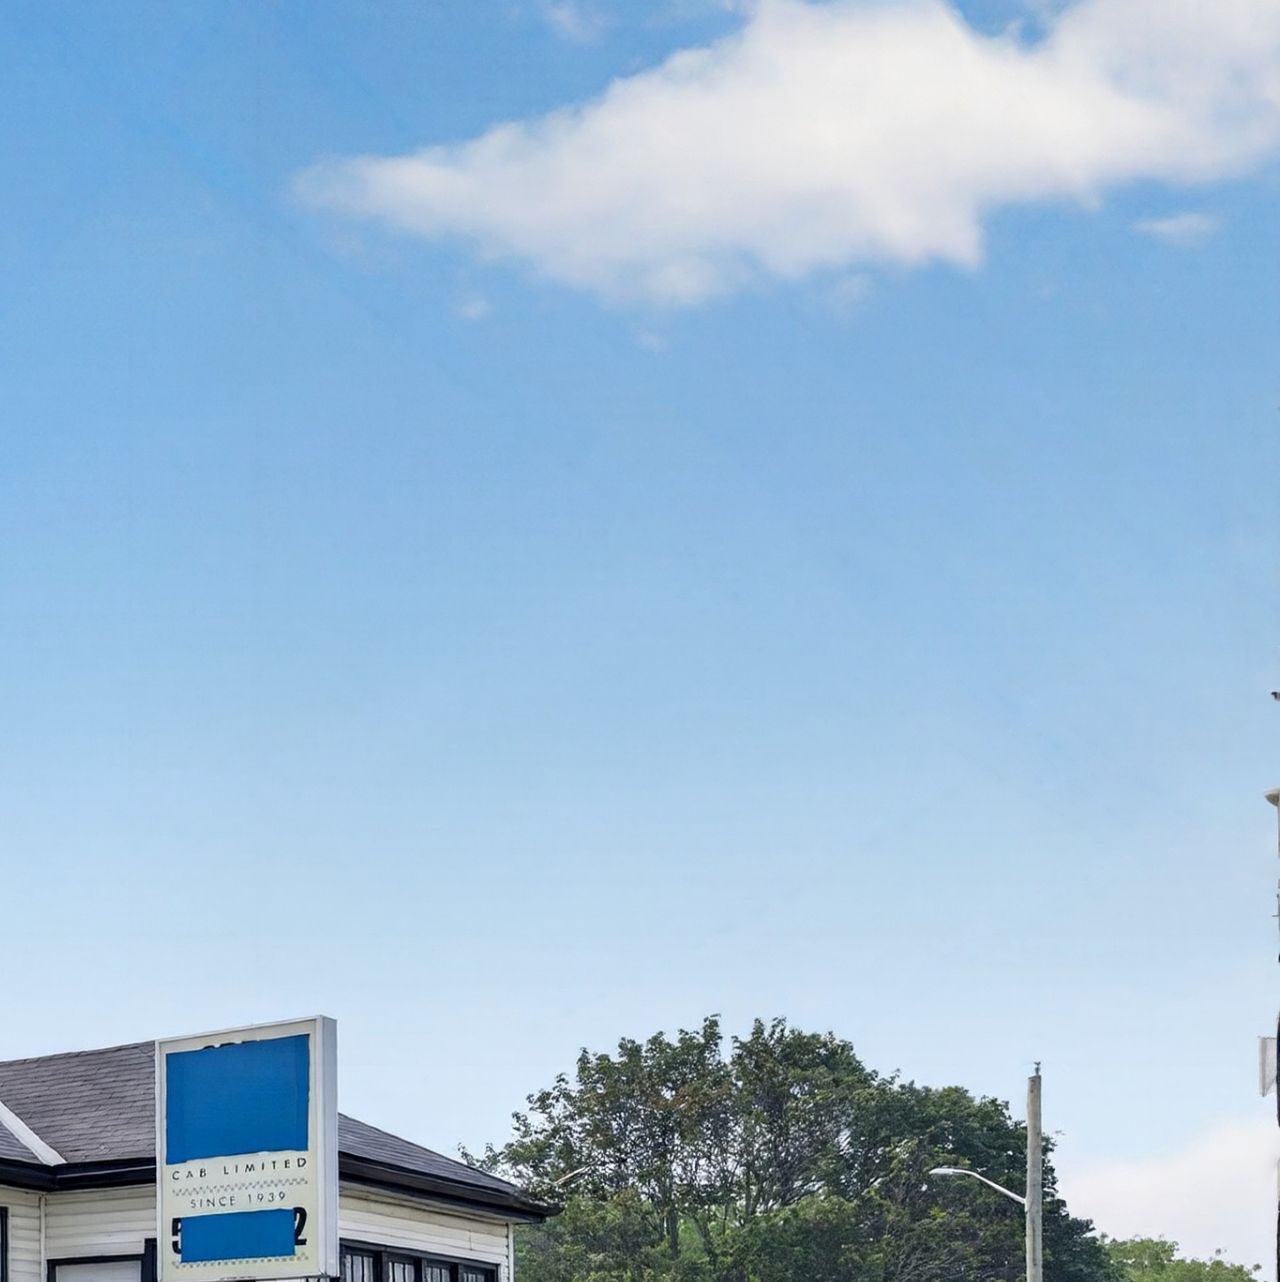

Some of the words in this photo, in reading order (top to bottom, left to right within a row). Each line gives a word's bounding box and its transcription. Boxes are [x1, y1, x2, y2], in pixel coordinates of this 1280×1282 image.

[172, 1167, 208, 1181] CAB
[223, 1157, 307, 1175] LIMITED
[190, 1195, 237, 1208] SINCE
[247, 1191, 287, 1204] 1939
